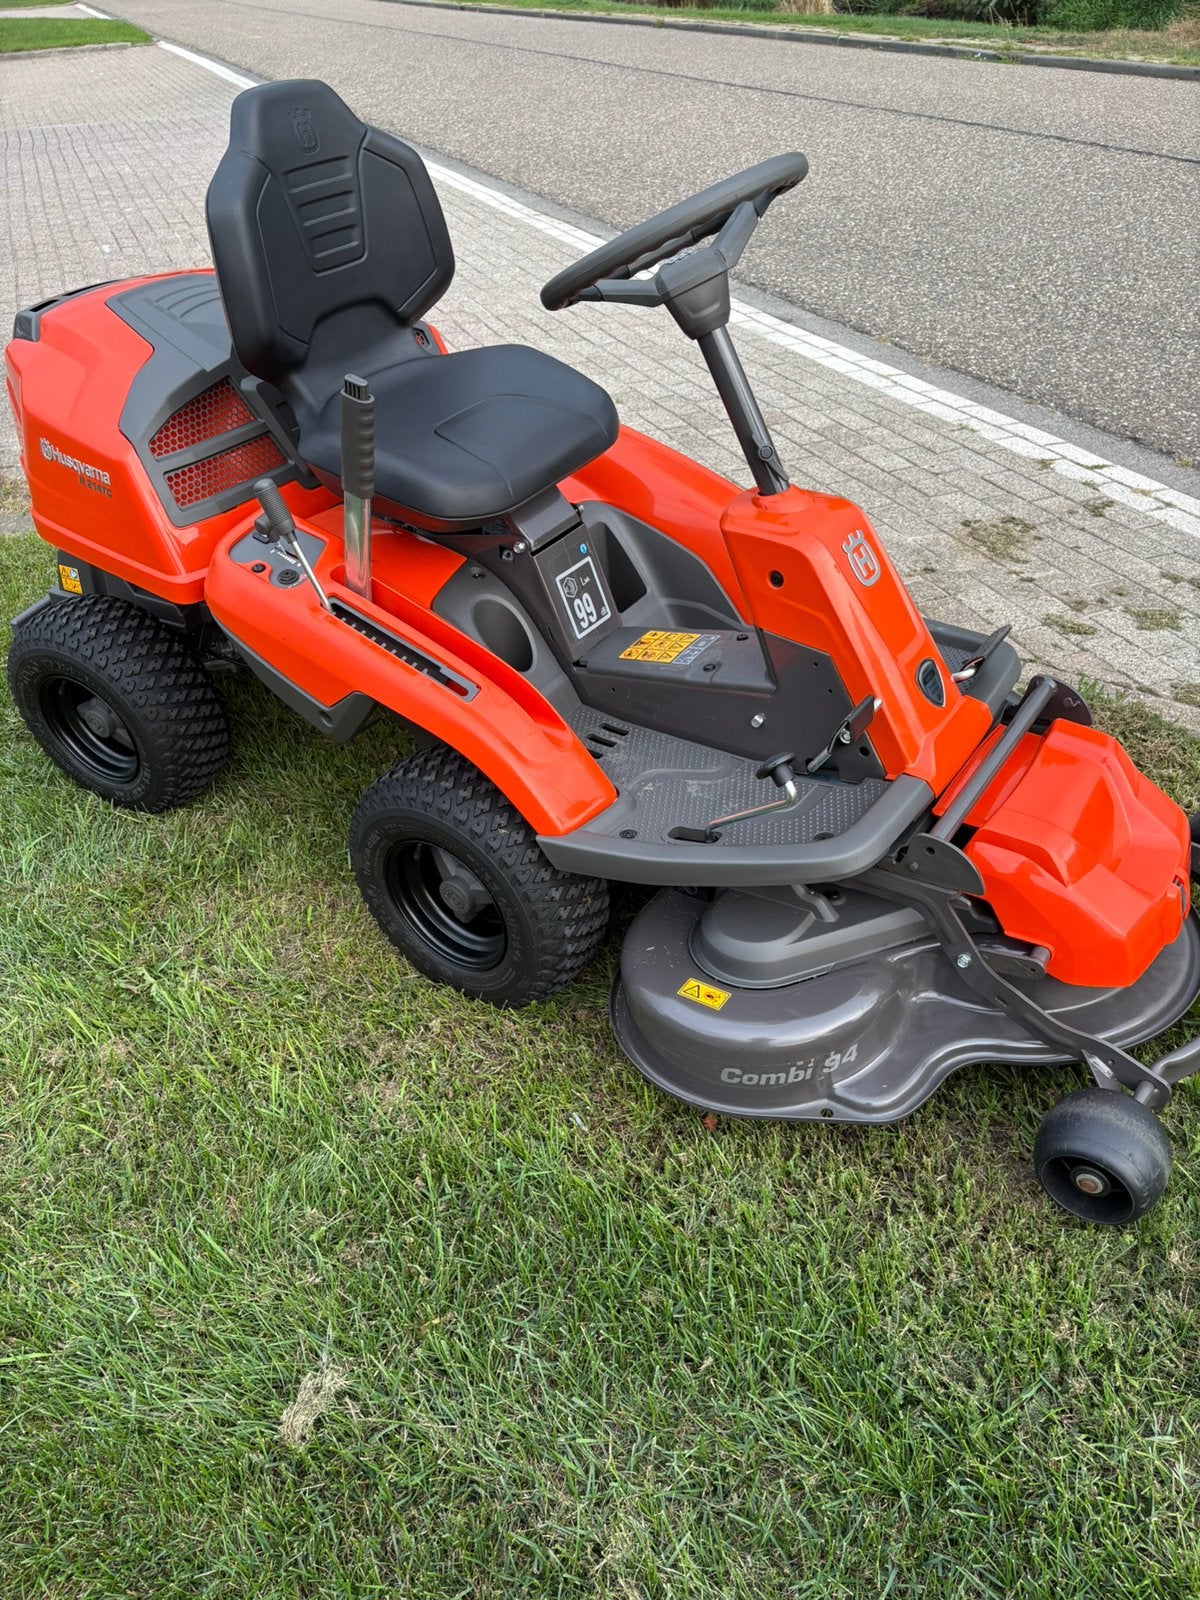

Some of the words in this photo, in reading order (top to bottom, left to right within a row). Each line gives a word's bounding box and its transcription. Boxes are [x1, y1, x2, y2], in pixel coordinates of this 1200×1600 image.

[51, 445, 111, 486] Husqvarna
[573, 592, 598, 629] 99
[720, 1061, 814, 1086] Combi
[822, 1043, 859, 1074] 94
